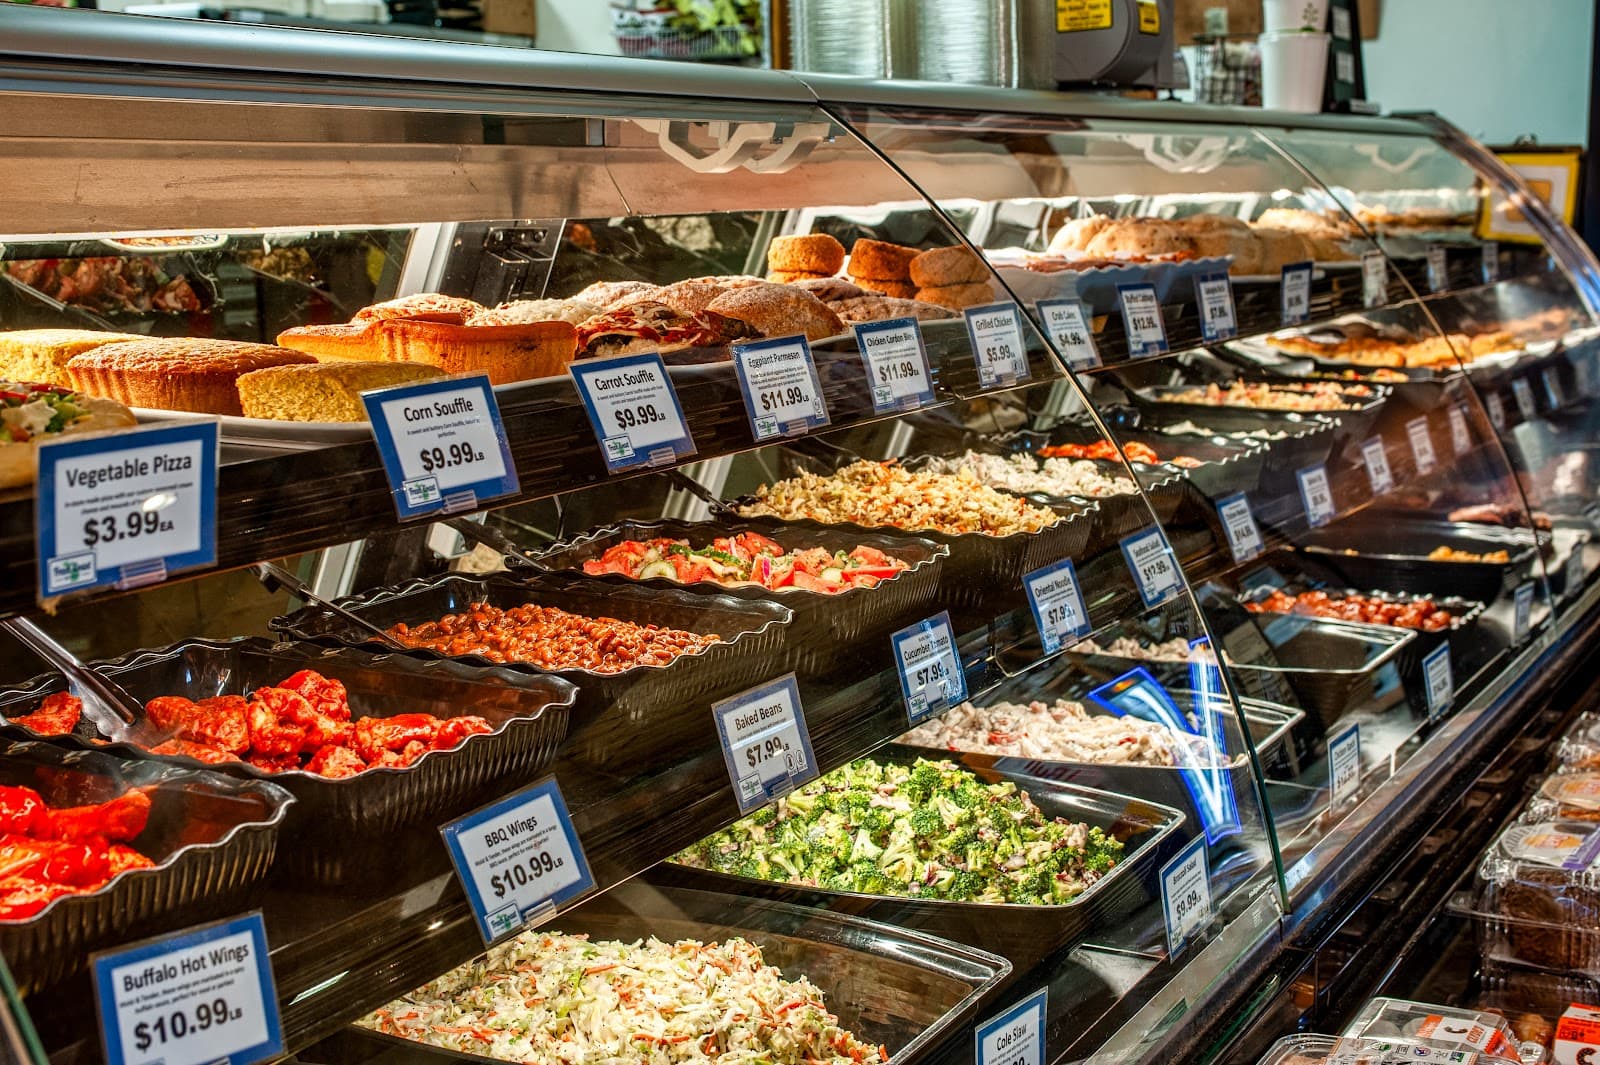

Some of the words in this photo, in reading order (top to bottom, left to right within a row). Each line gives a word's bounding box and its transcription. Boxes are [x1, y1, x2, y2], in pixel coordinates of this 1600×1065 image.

[976, 318, 993, 331] Grilled
[994, 316, 1013, 328] Chicken
[866, 337, 886, 347] Chicken
[748, 356, 773, 370] Eggplant
[595, 375, 624, 391] Carrot
[625, 370, 655, 386] Souffle
[404, 407, 432, 422] Corn
[434, 397, 473, 417] Souffle
[66, 458, 148, 488] Vegetable
[154, 454, 192, 474] Pizza
[1035, 582, 1055, 598] Oriental
[904, 643, 930, 661] Cucumber
[735, 710, 758, 731] Baked
[760, 703, 783, 720] Beans
[485, 828, 508, 848] BBQ
[507, 816, 538, 836] Wings
[123, 963, 178, 992] Buffalo
[181, 955, 206, 975] Hot
[209, 943, 249, 969] Wings
[996, 1032, 1012, 1051] Cole
[1012, 1023, 1027, 1042] Slaw
